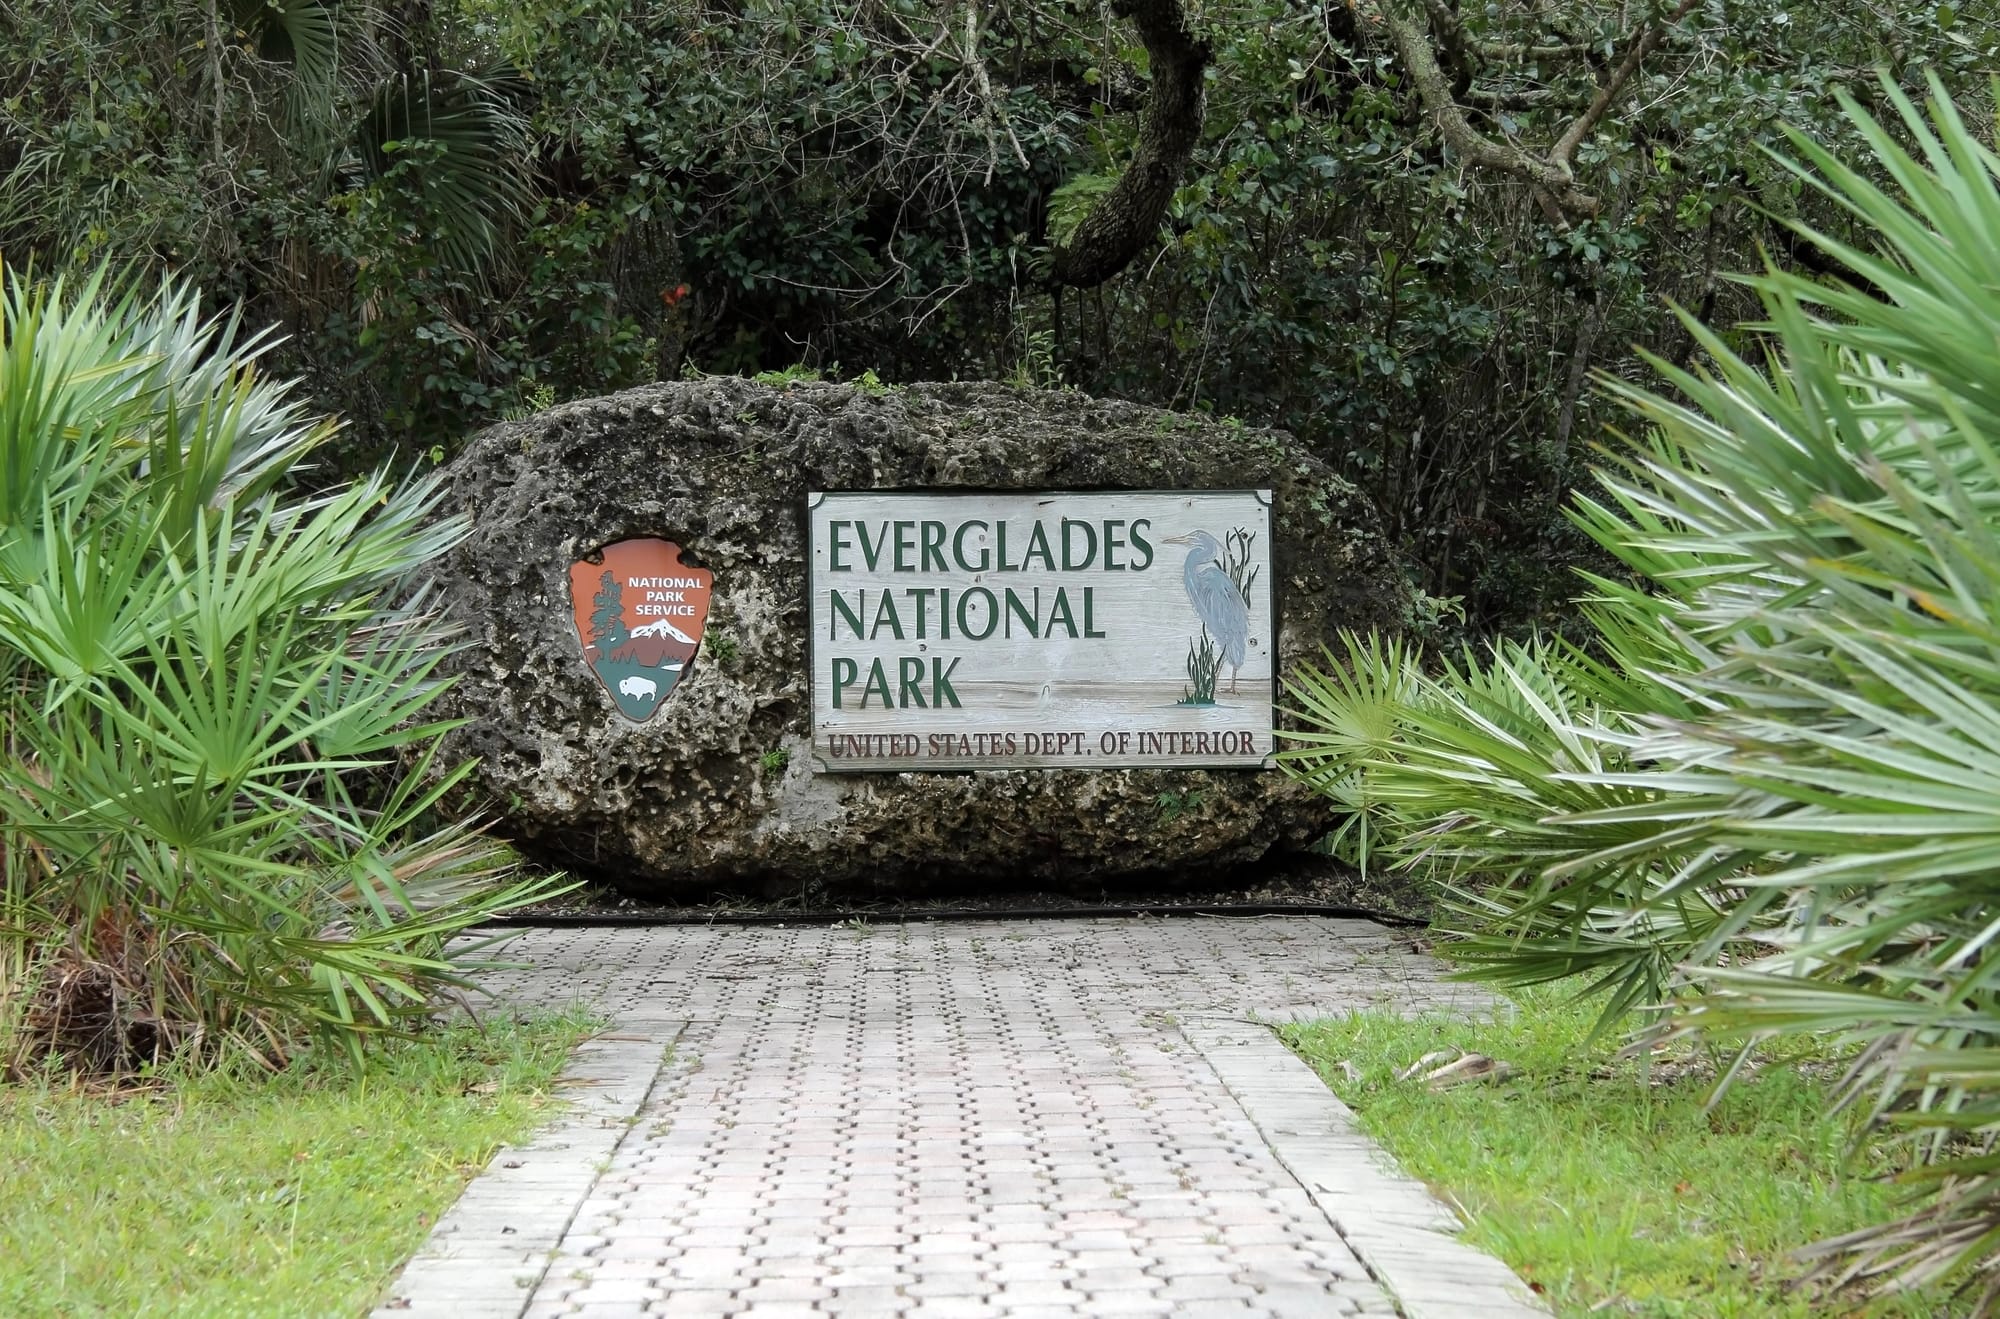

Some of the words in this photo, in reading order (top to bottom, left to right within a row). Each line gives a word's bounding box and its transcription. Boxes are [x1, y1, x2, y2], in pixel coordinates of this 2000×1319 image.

[829, 519, 1154, 572] EVERGLADES
[628, 577, 704, 589] NATIONAL
[646, 591, 685, 602] PARK
[635, 605, 696, 616] SERVICE
[830, 586, 1106, 641] NATIONAL
[831, 656, 962, 709] PARK
[828, 733, 921, 758] UNITED
[927, 732, 1017, 757] STATES
[1024, 731, 1092, 756] DEPT.
[1100, 731, 1131, 755] OF
[1137, 730, 1256, 755] INTERIOR
